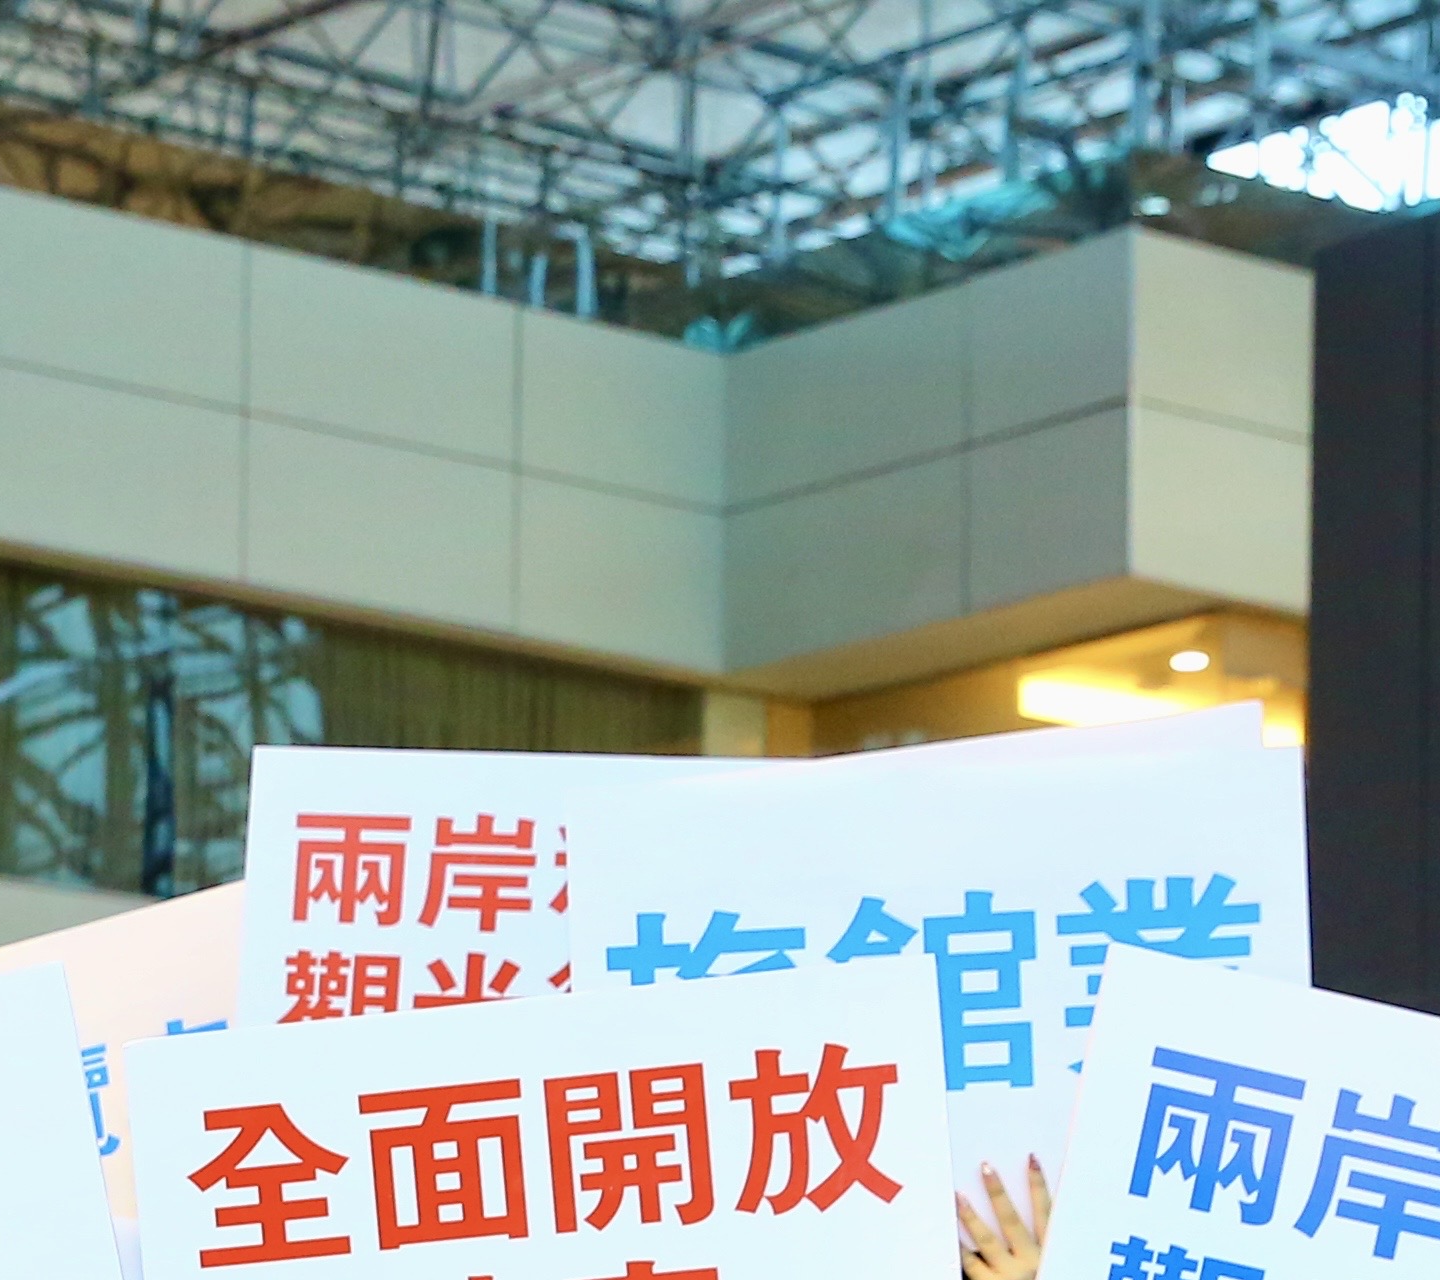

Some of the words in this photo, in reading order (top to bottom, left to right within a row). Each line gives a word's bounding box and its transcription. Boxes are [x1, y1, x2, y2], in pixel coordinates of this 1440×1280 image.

[293, 813, 569, 932] 兩岸
[190, 1043, 902, 1269] 全面開放
